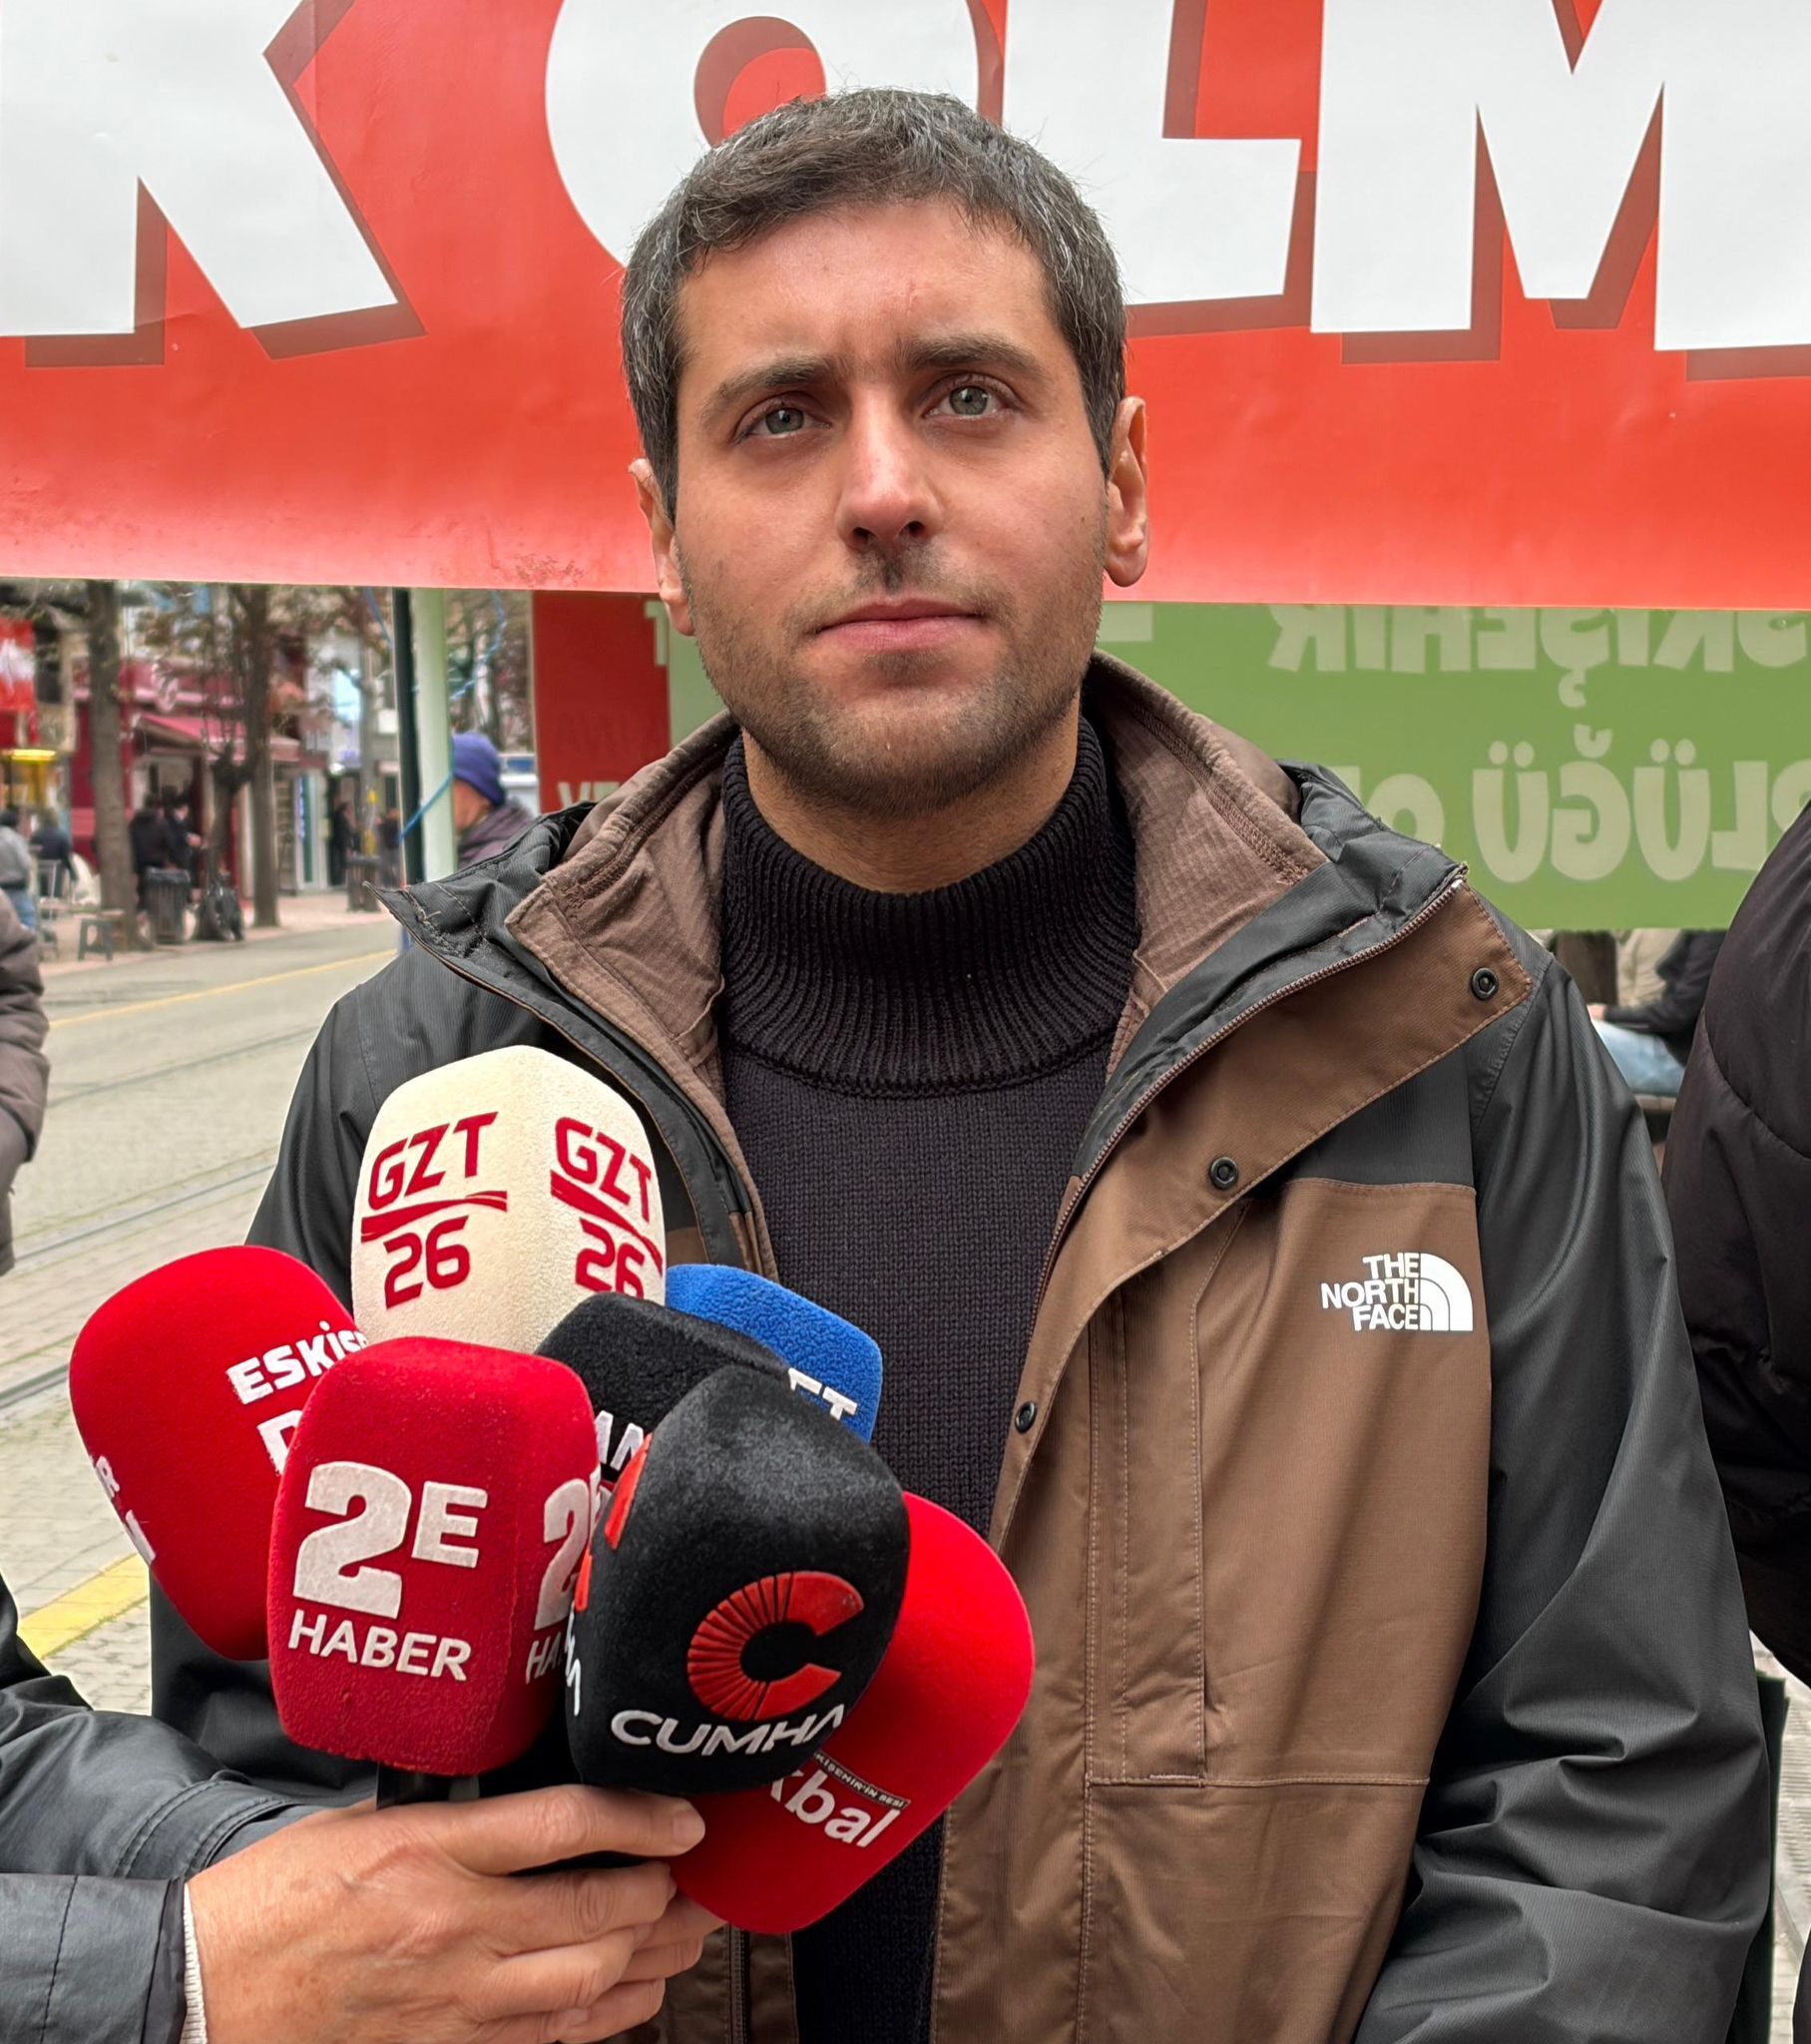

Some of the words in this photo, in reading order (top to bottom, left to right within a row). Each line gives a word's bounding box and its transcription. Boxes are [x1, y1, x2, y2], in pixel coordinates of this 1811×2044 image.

[368, 1112, 498, 1211] GZT
[555, 1117, 652, 1223] GZT
[384, 1216, 470, 1309] 26
[575, 1218, 645, 1300] 26
[1321, 1278, 1418, 1308] NORTH
[1363, 1253, 1419, 1278] THE
[1353, 1303, 1418, 1331] FACE
[293, 1460, 488, 1619] 2E
[288, 1609, 471, 1682] HABER
